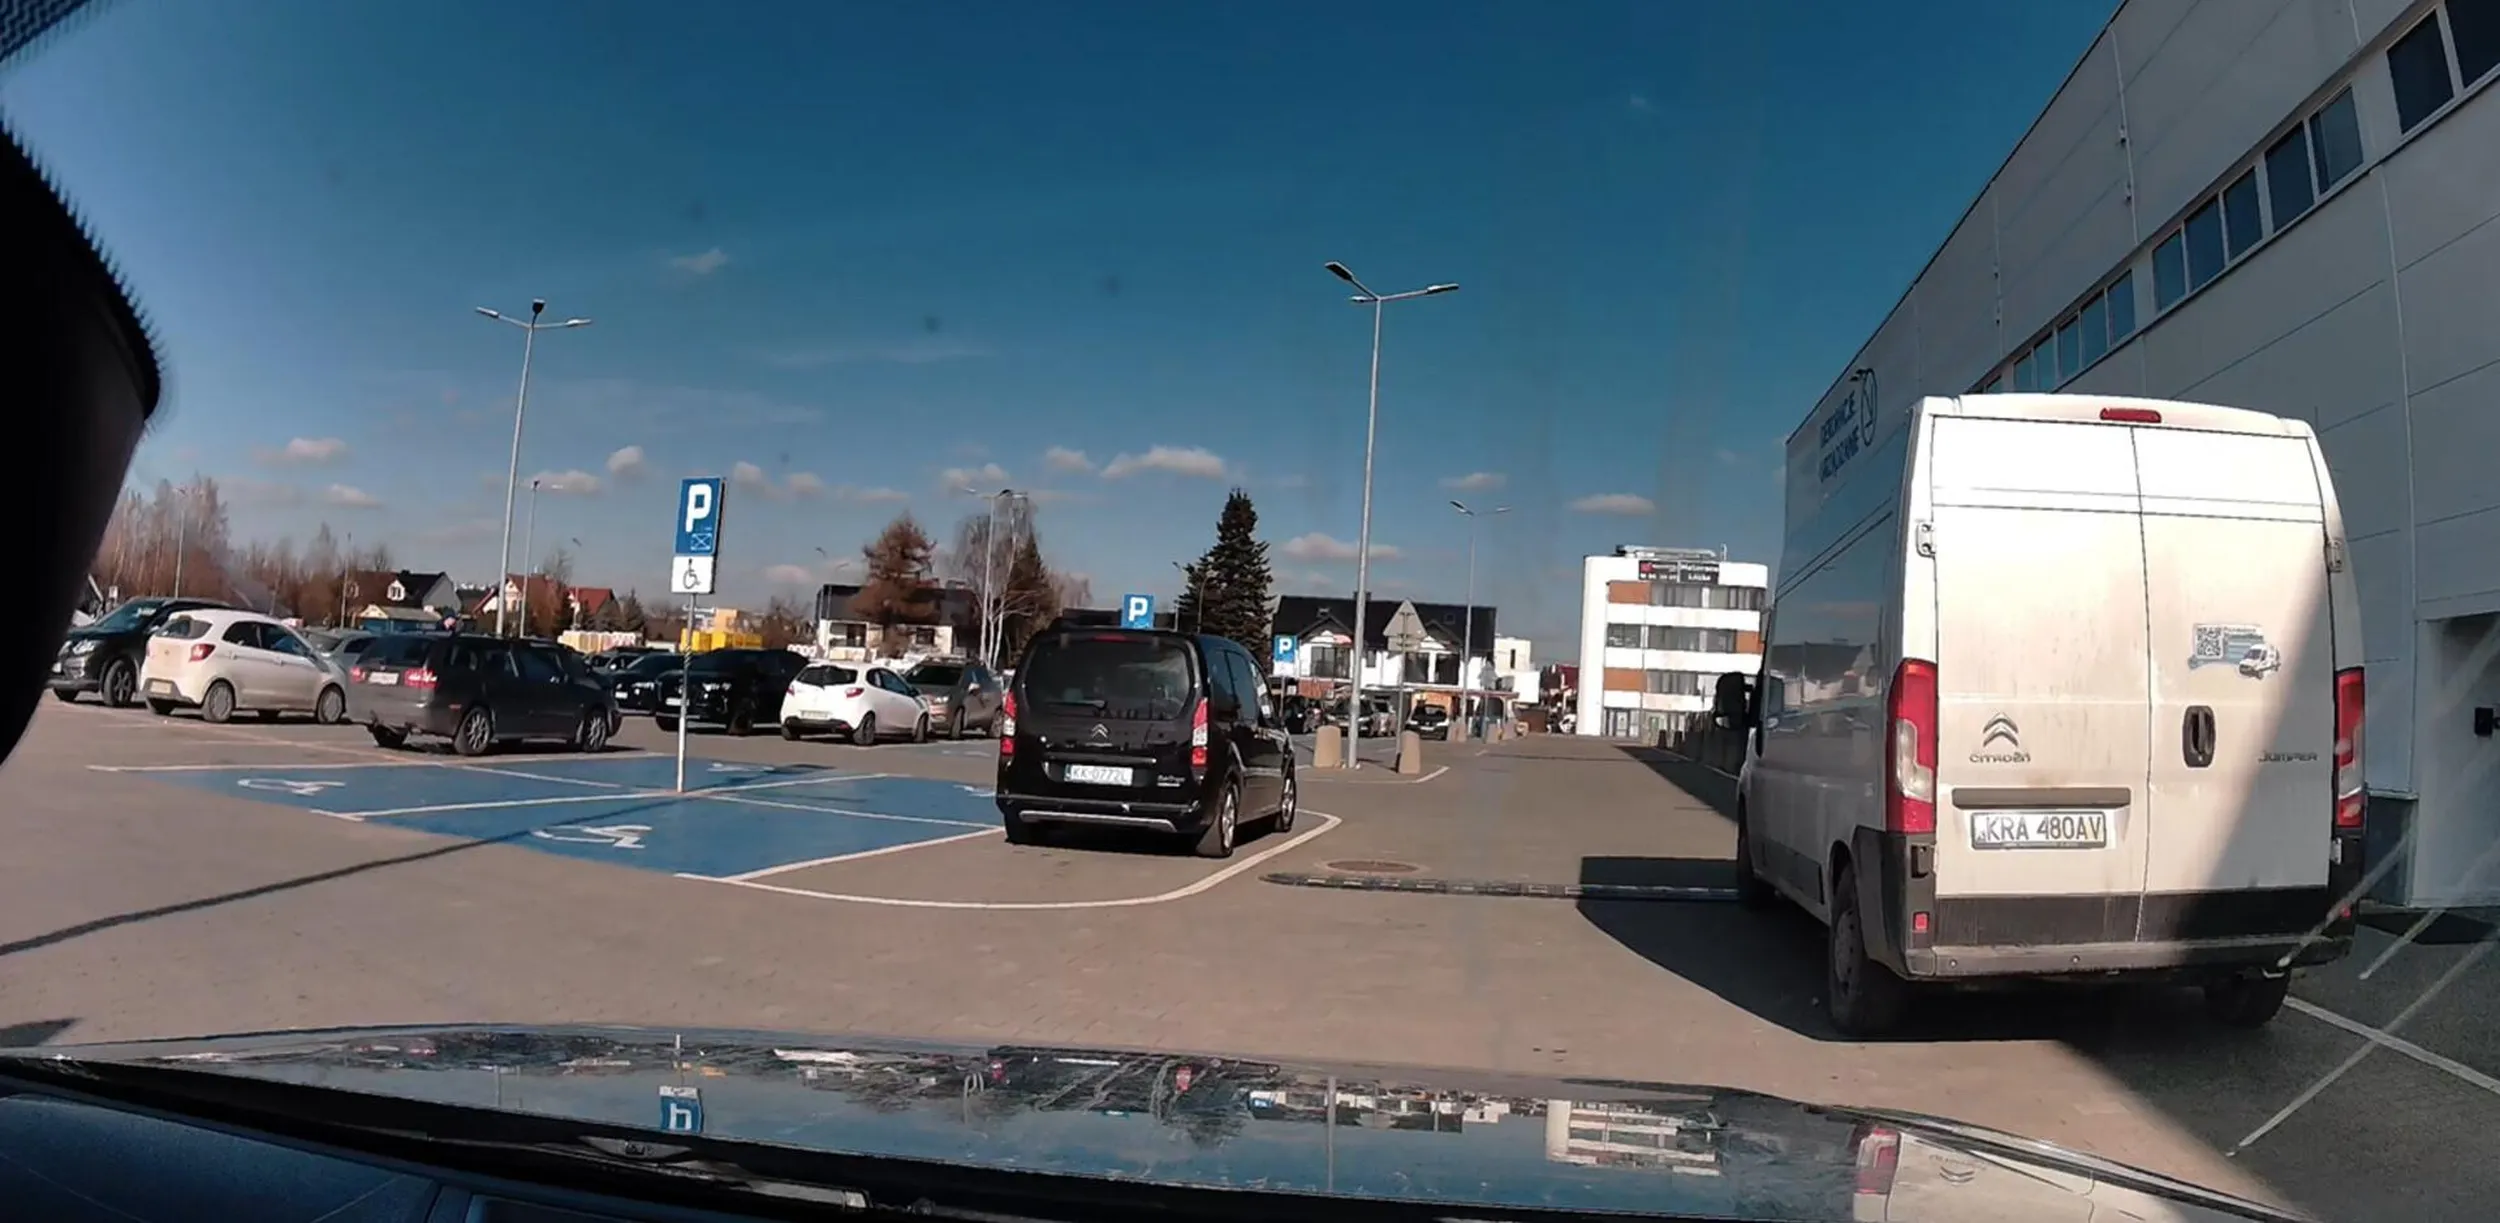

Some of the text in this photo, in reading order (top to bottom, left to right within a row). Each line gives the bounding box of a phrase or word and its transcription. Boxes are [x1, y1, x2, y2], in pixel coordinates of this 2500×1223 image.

[685, 483, 712, 533] P
[1129, 597, 1148, 622] P
[1279, 638, 1292, 654] P
[1986, 815, 2101, 841] KRA 480AV
